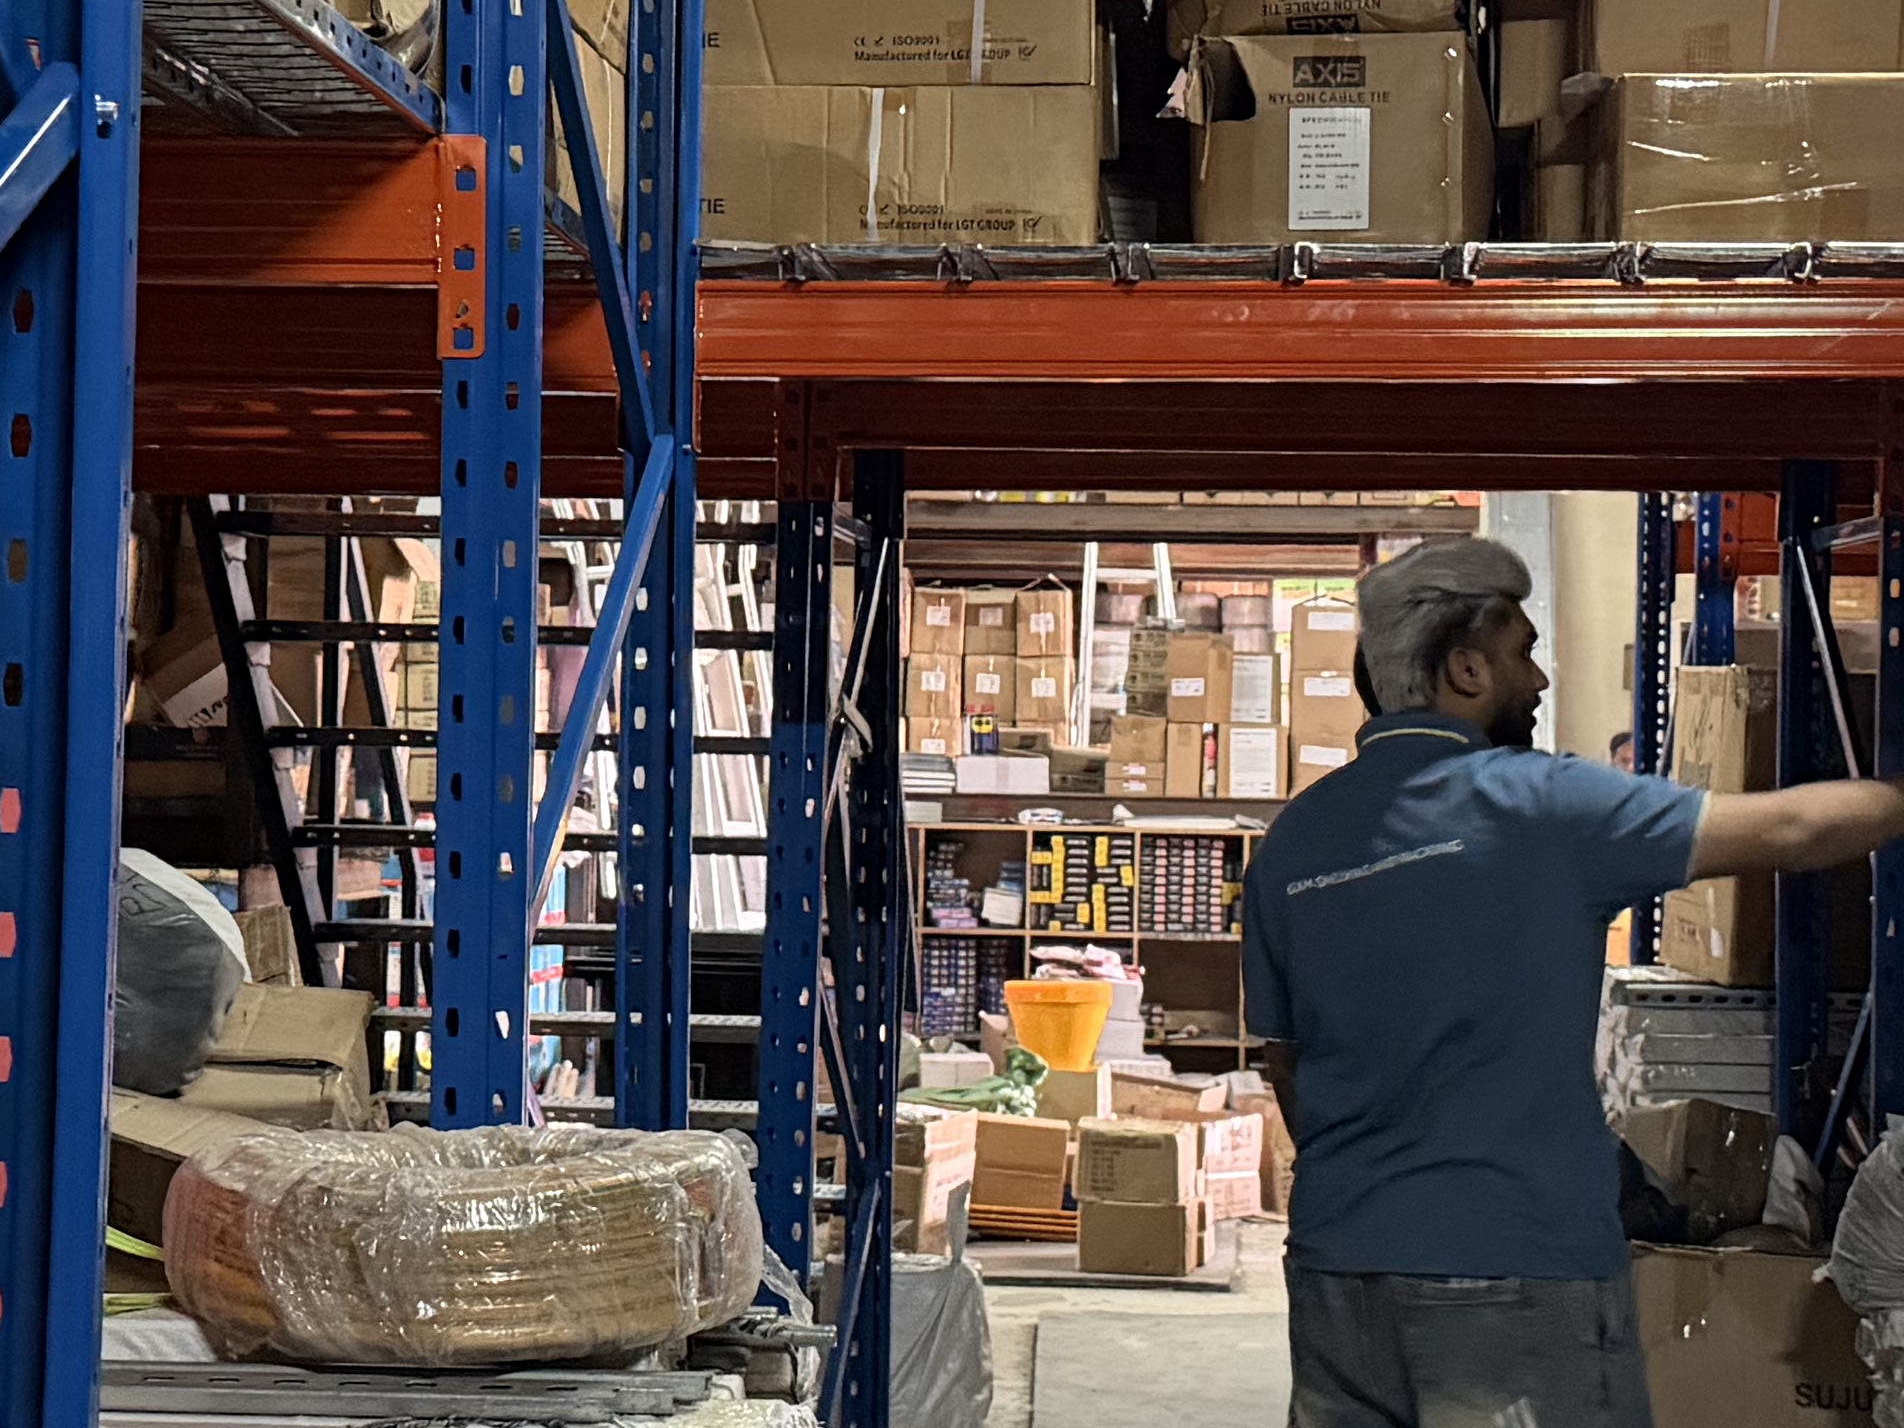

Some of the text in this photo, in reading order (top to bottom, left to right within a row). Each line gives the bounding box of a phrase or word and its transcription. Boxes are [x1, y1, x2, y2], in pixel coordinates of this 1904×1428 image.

[1284, 0, 1330, 14] CABLE
[854, 49, 931, 62] Manufactured
[932, 49, 948, 61] for
[1294, 61, 1362, 88] AXIS
[1268, 90, 1391, 104] NYLON CABLE TIE
[938, 219, 953, 231] for
[977, 219, 1016, 232] GROUP
